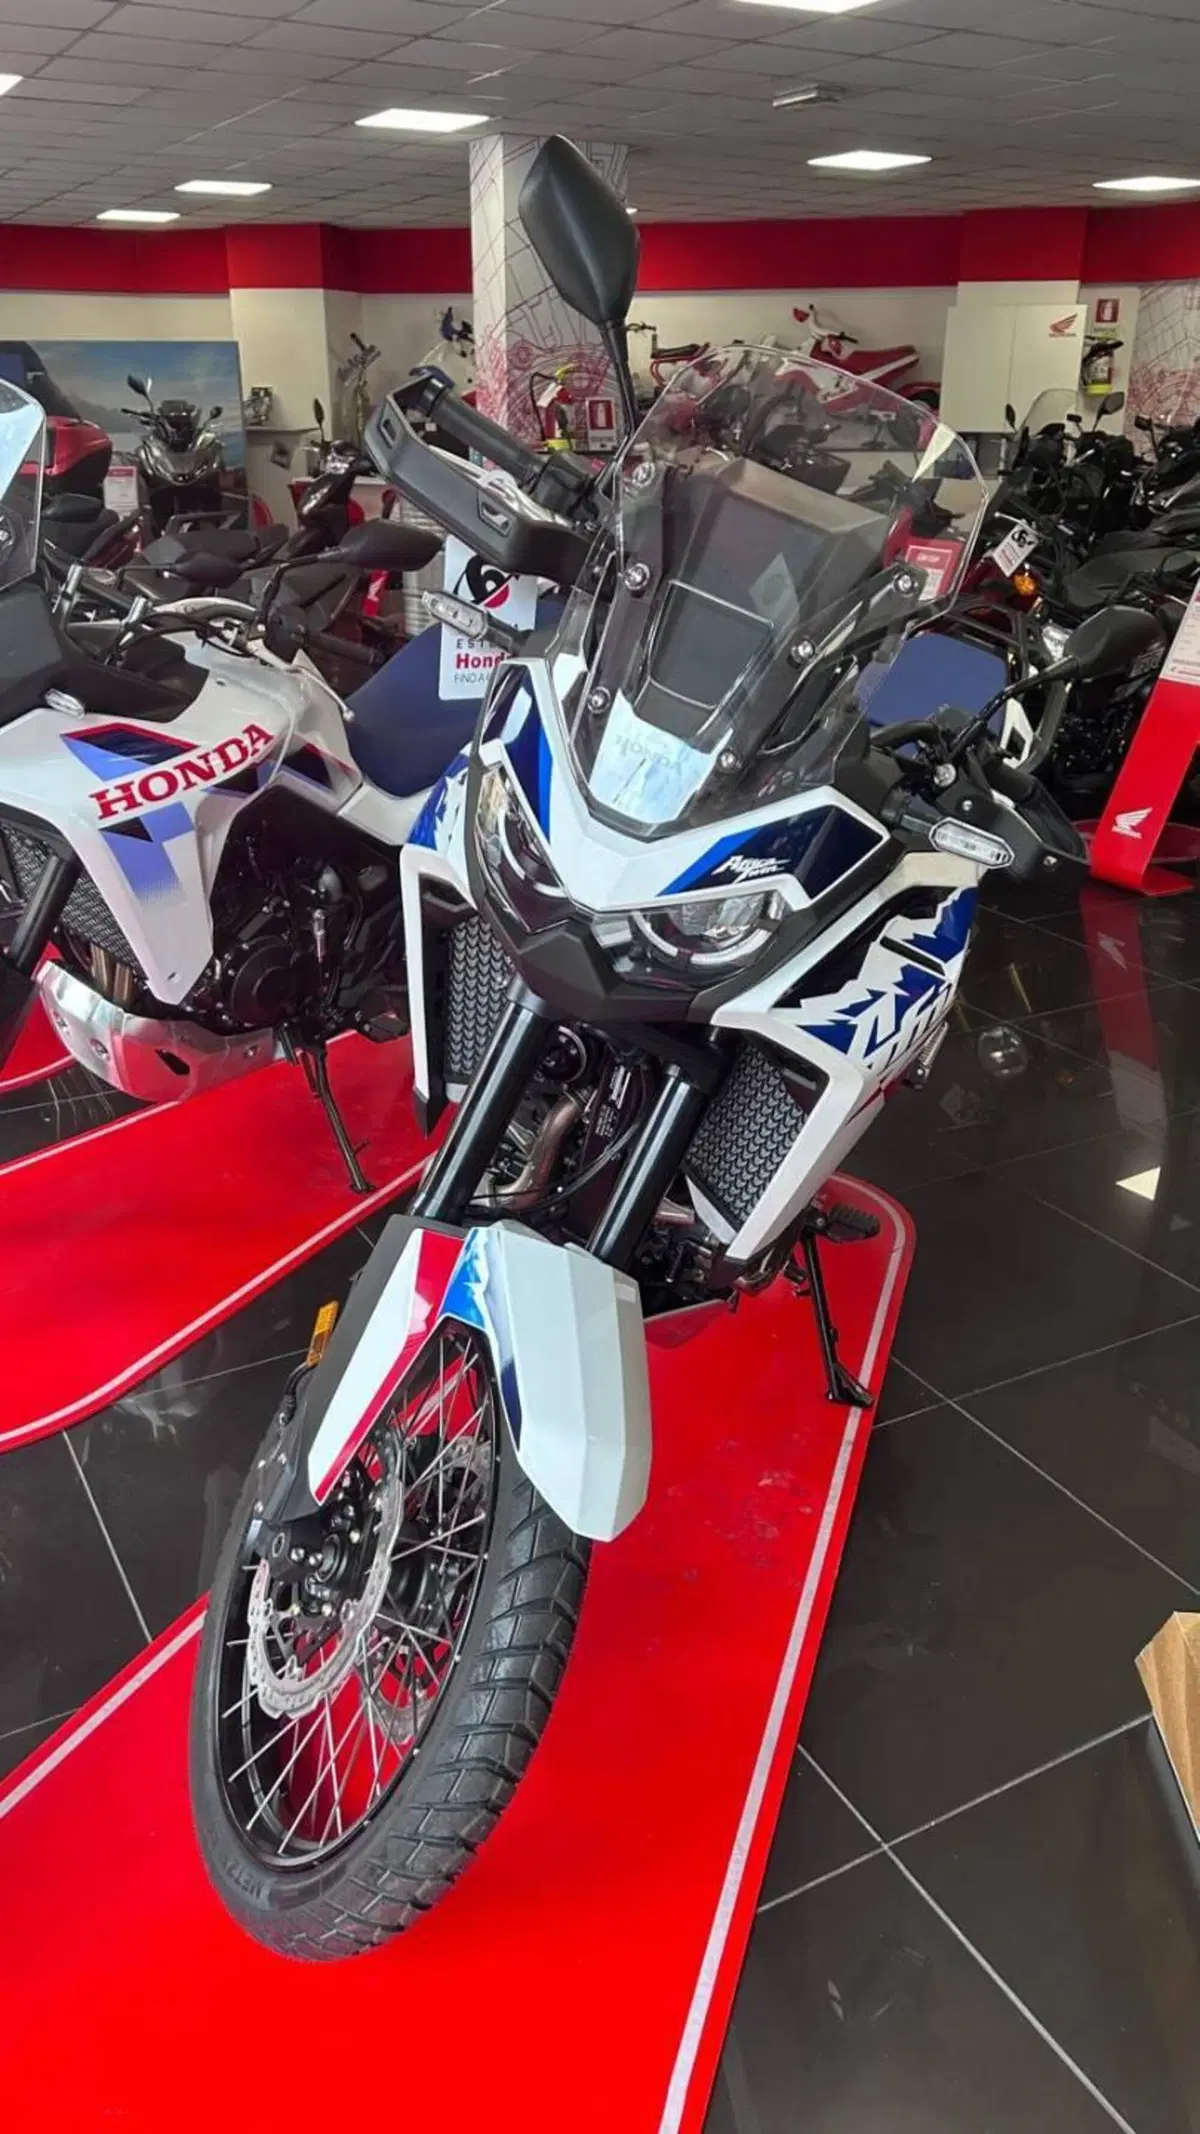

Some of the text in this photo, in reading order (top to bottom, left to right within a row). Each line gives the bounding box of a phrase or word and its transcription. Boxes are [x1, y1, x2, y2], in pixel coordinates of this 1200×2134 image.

[456, 638, 494, 649] EST
[456, 652, 507, 669] Hond
[89, 724, 274, 819] HONDA
